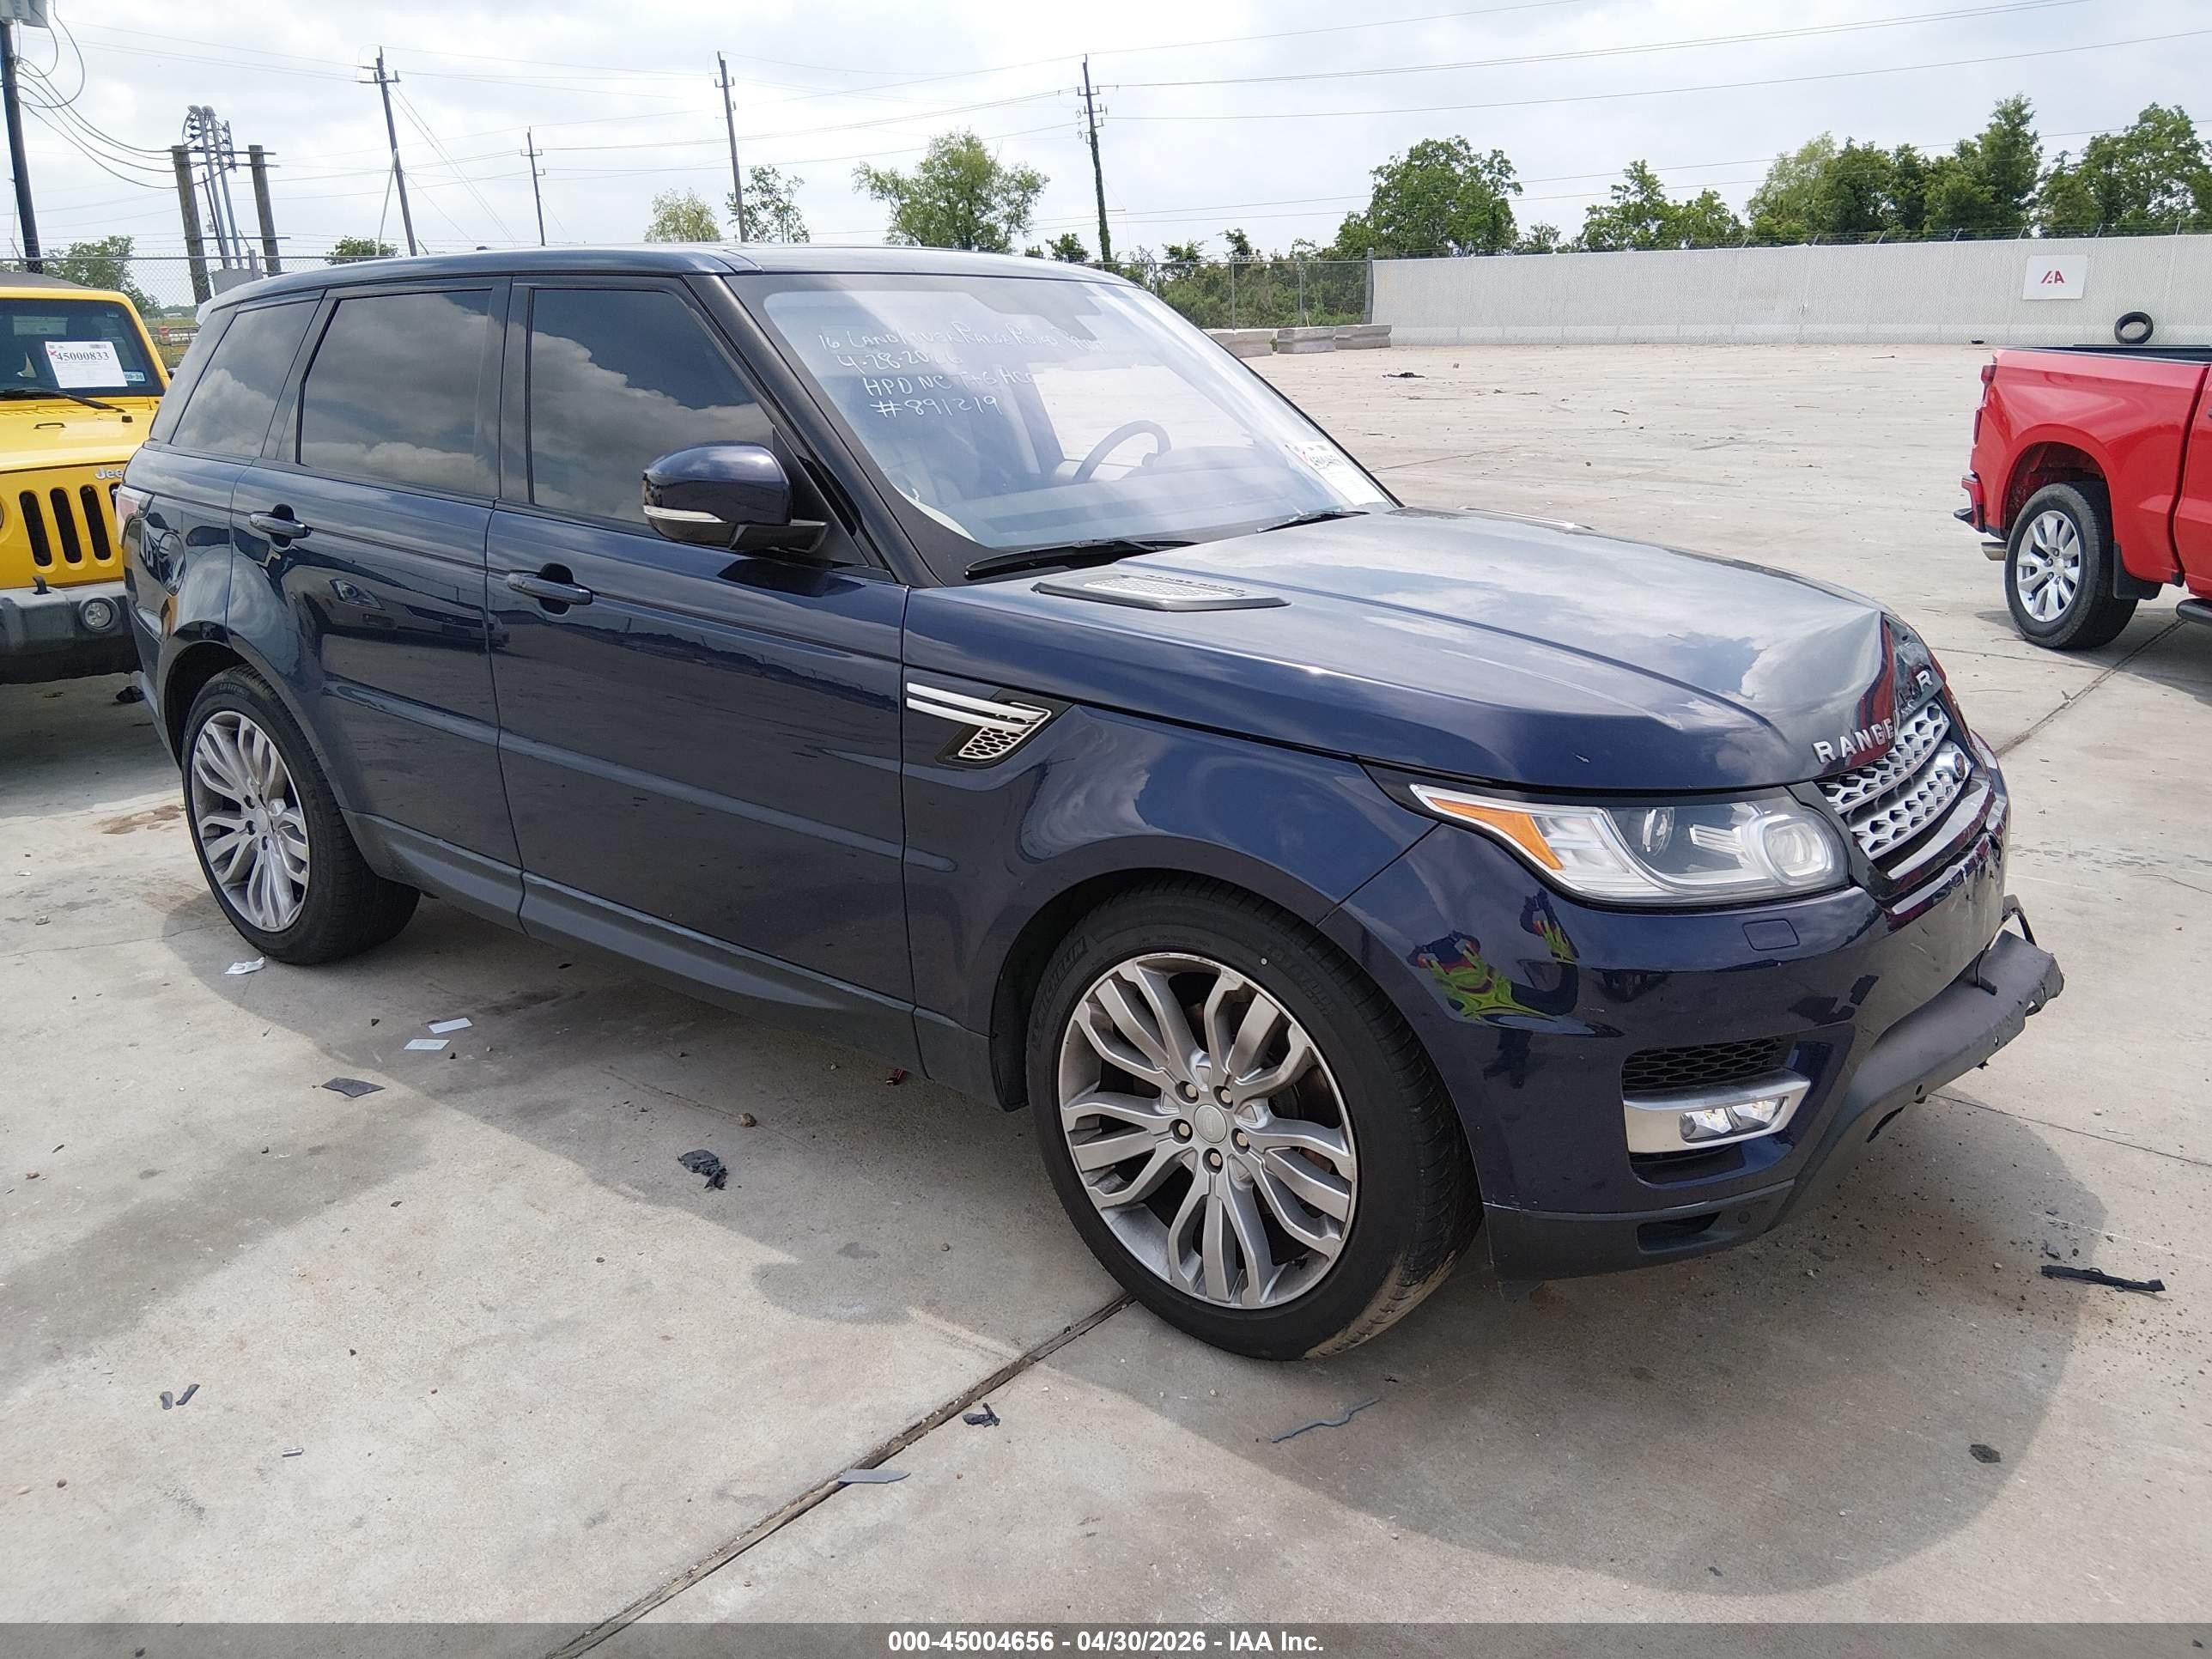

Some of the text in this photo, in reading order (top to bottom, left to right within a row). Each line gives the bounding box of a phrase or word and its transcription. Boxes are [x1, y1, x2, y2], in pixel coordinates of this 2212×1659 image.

[56, 350, 110, 362] 45000833
[862, 376, 913, 397] HPD
[95, 466, 124, 480] Jee
[1813, 718, 1894, 763] RANGE
